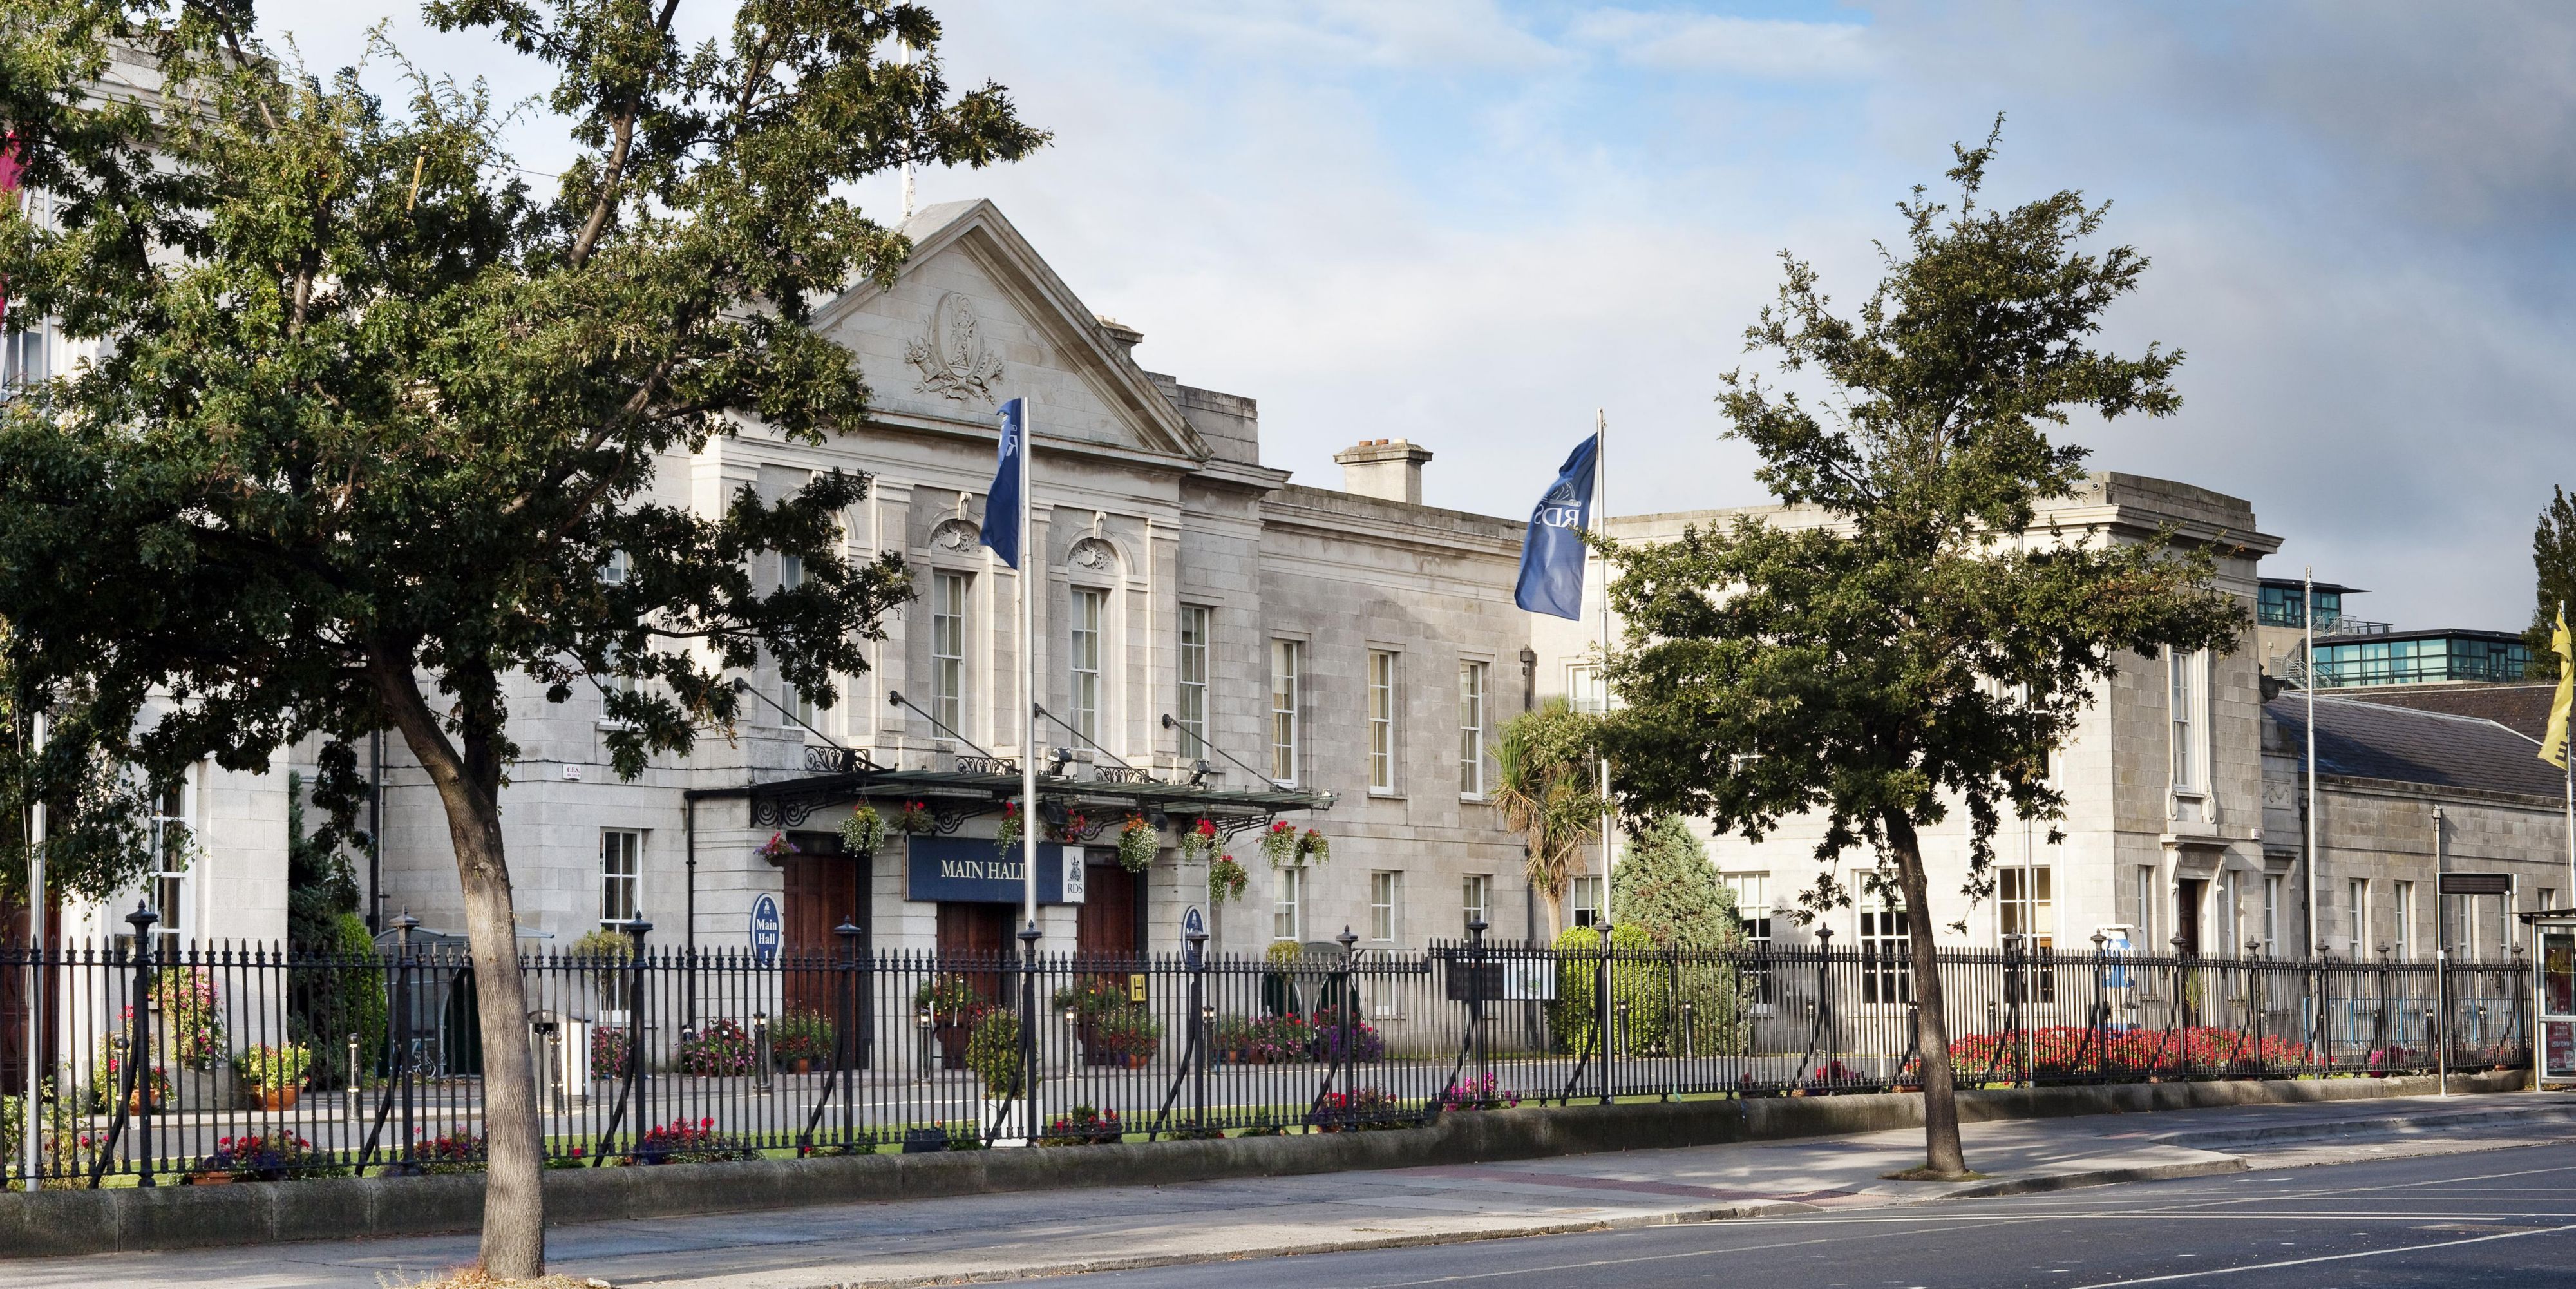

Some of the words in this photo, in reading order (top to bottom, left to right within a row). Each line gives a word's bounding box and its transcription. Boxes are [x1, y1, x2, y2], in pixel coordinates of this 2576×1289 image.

[941, 860, 984, 879] MAIN
[1068, 883, 1083, 893] RDS
[756, 919, 777, 930] Main
[758, 933, 775, 944] Hall
[764, 950, 768, 962] 1
[1133, 977, 1144, 998] H
